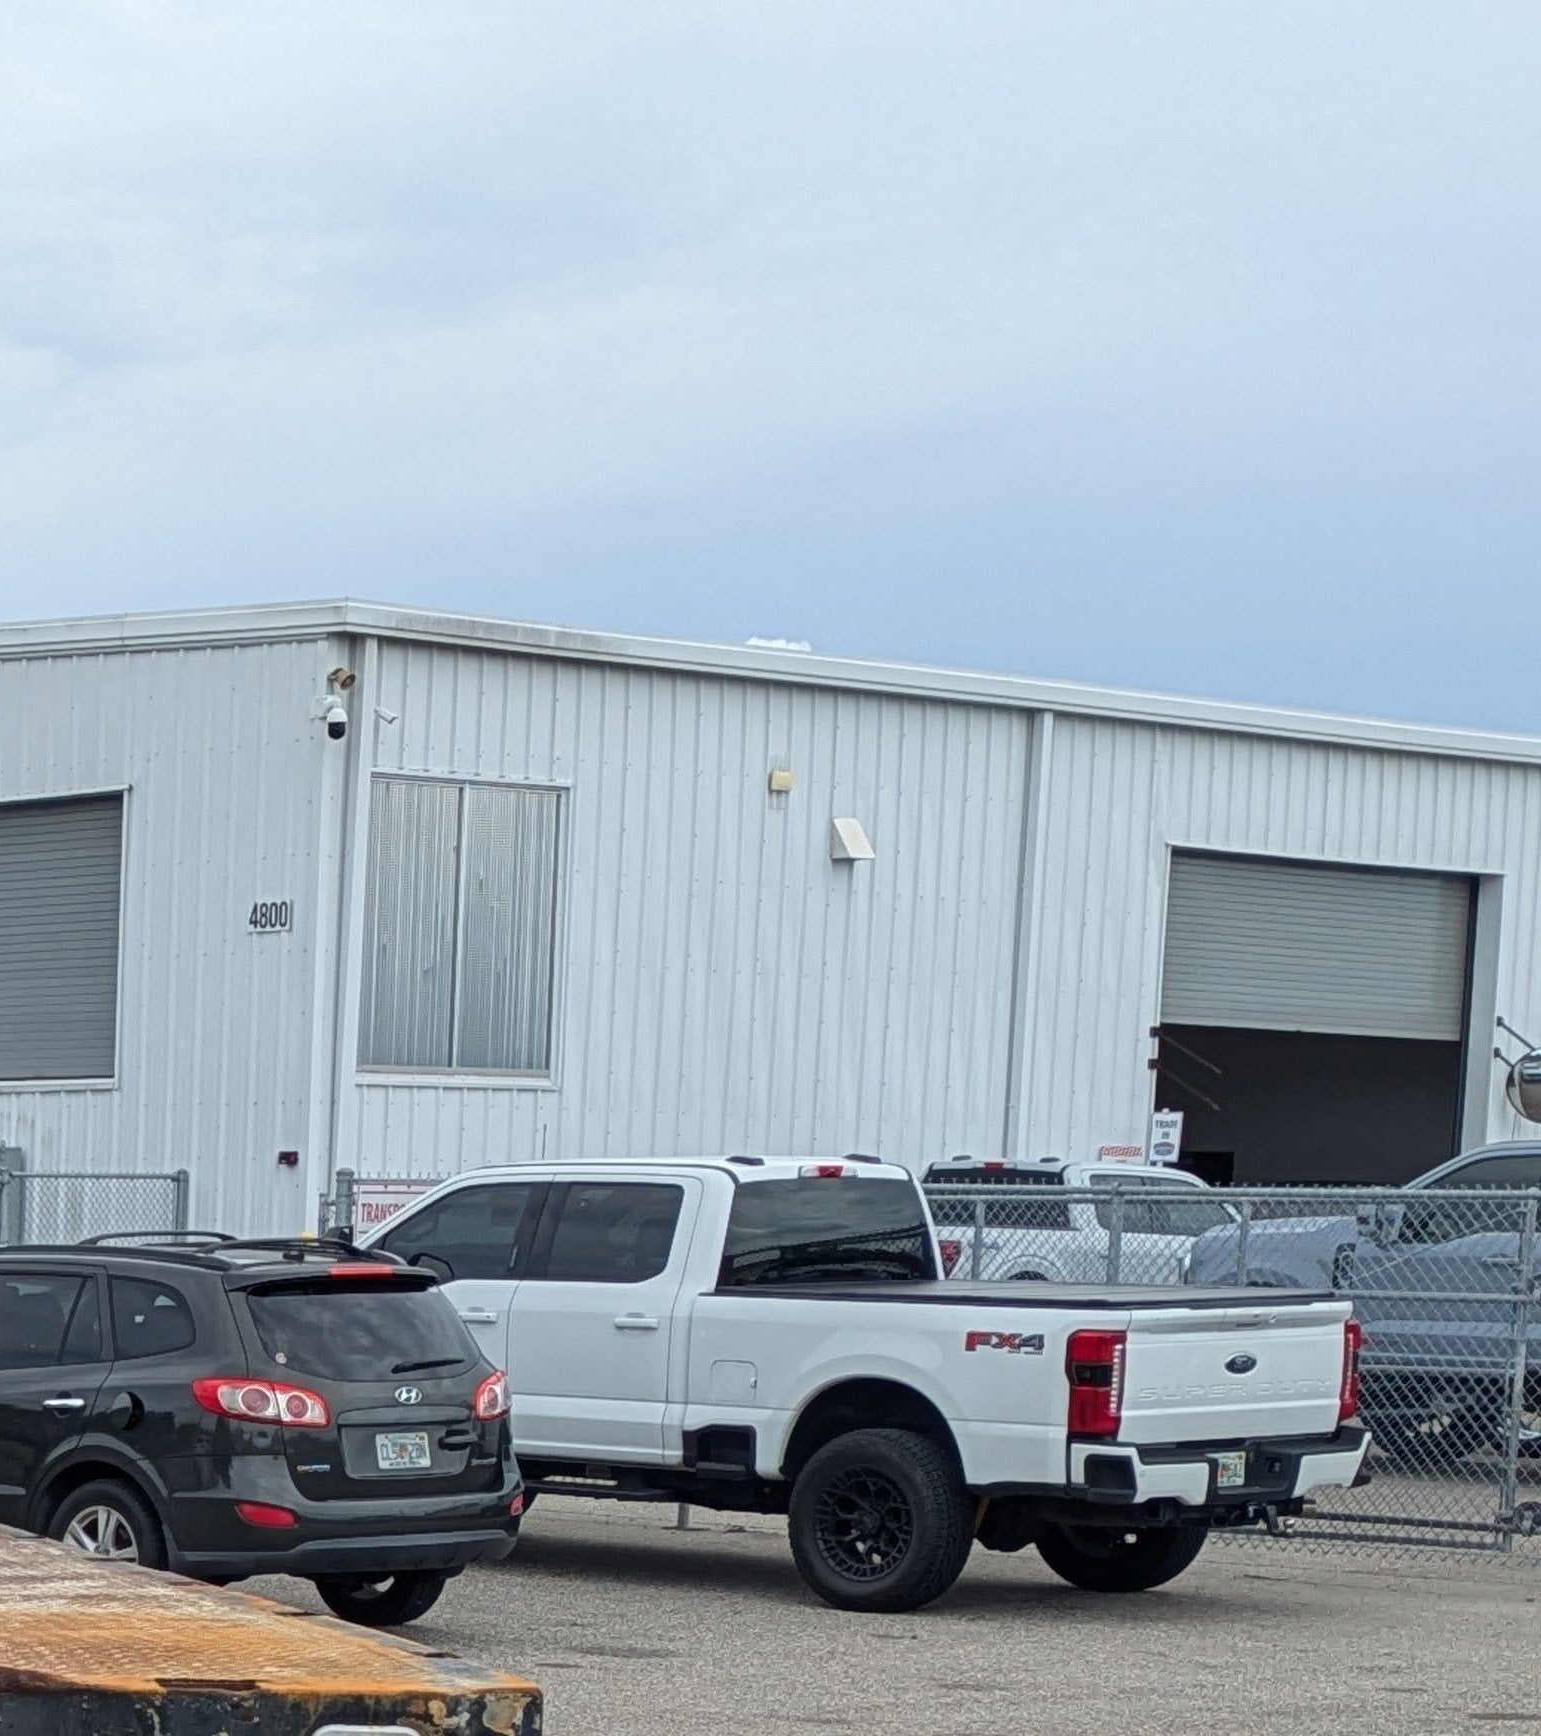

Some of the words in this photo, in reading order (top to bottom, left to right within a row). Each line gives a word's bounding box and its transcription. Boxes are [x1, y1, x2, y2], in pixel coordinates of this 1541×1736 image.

[249, 901, 288, 929] 4800
[965, 1332, 1045, 1351] FX4
[1138, 1383, 1247, 1401] SUPER
[1256, 1378, 1332, 1396] DUTY
